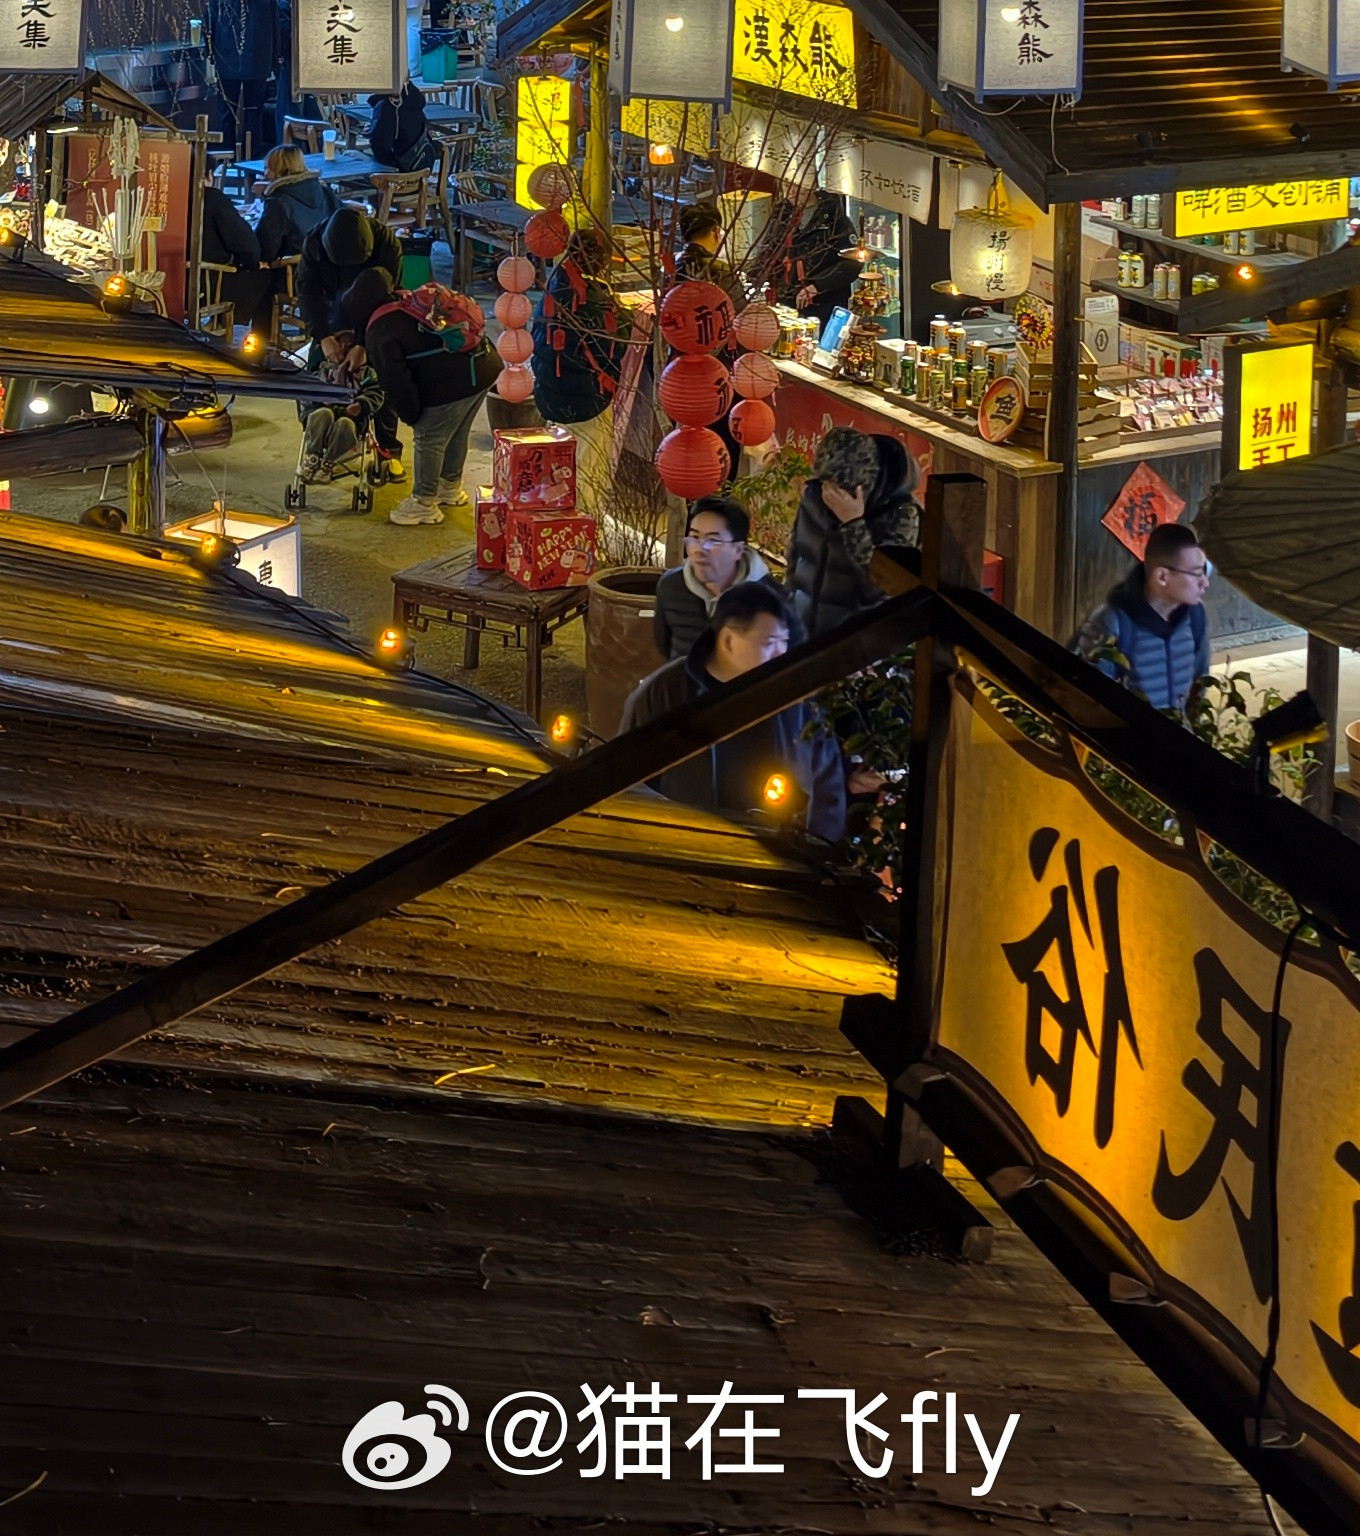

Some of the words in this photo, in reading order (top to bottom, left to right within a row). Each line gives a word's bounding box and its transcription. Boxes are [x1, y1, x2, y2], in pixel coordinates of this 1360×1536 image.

[742, 8, 848, 83] 漢森熊
[1252, 401, 1298, 439] 扬州
